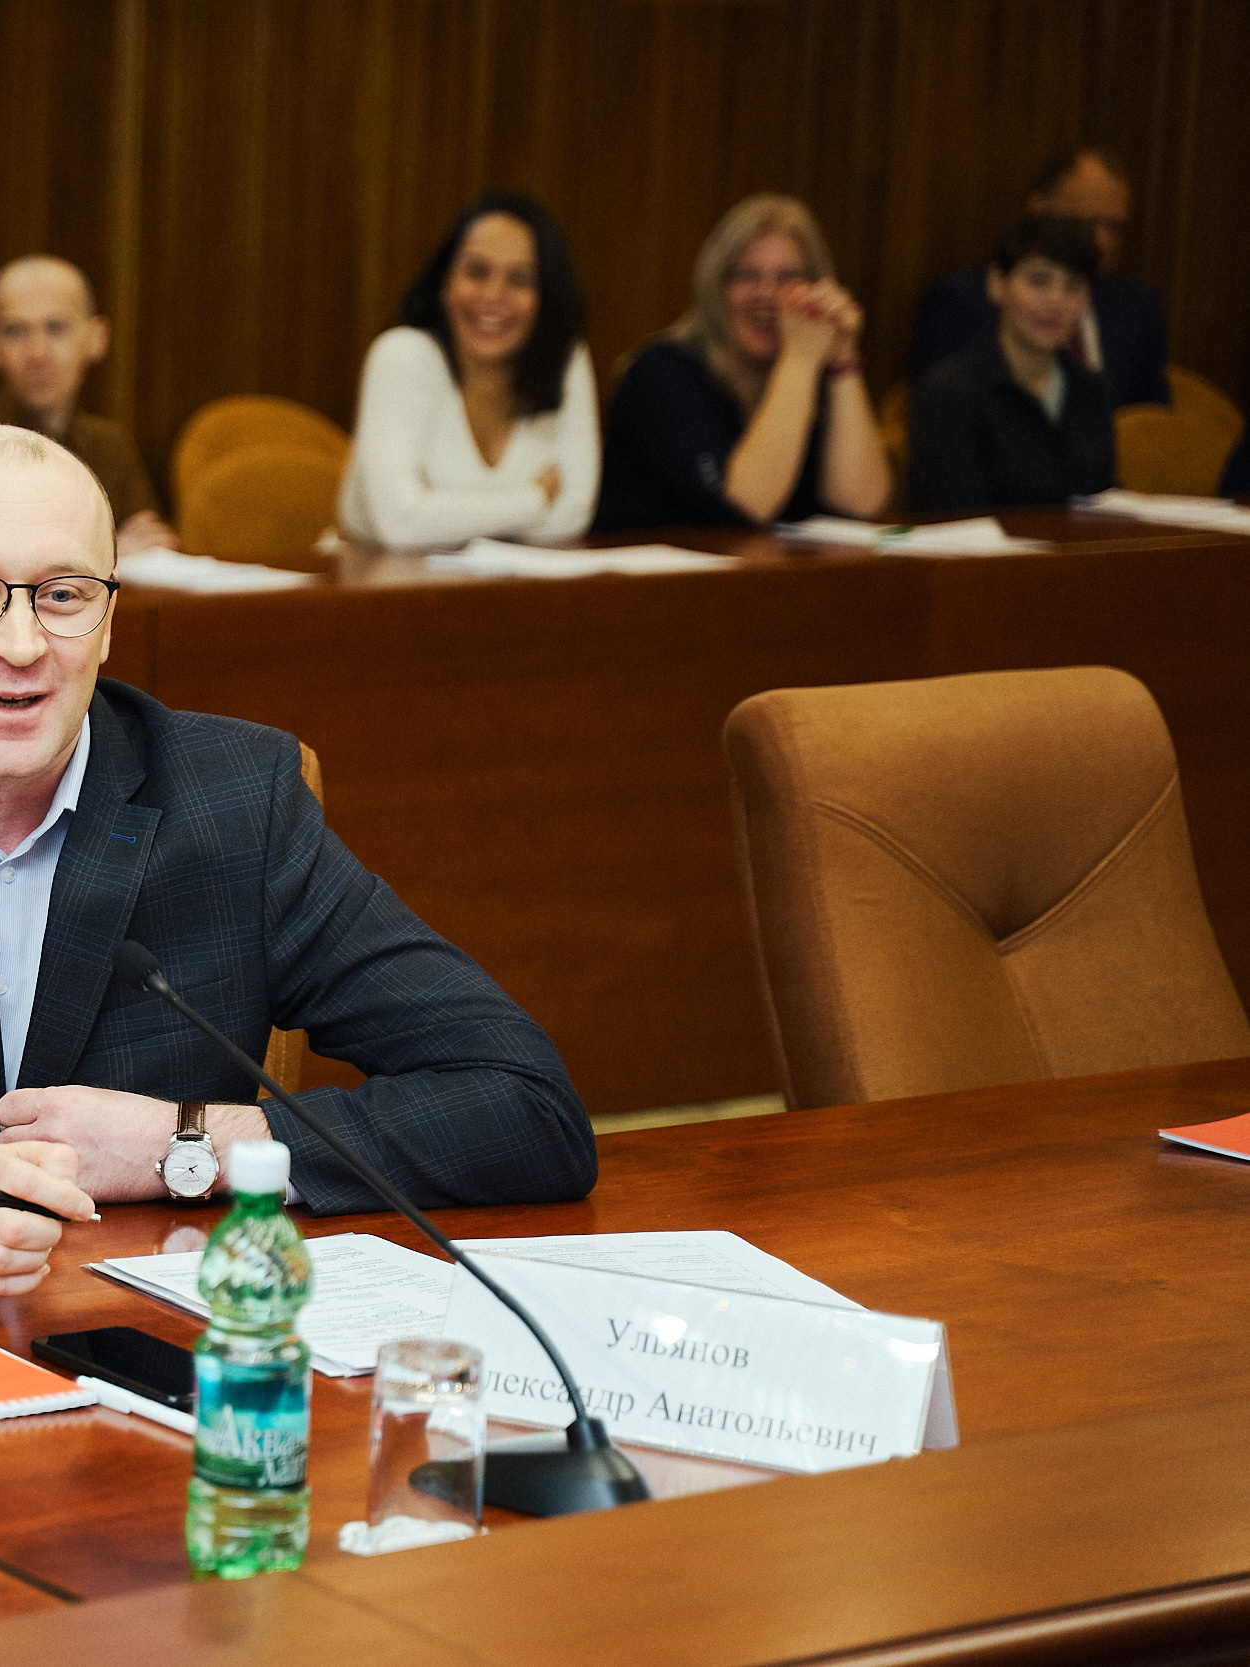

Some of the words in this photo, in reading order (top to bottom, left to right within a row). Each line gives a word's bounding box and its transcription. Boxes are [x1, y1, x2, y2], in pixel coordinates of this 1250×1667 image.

[607, 1317, 749, 1369] Ульянов
[484, 1369, 635, 1421] лександр
[646, 1390, 878, 1456] Анатольевич
